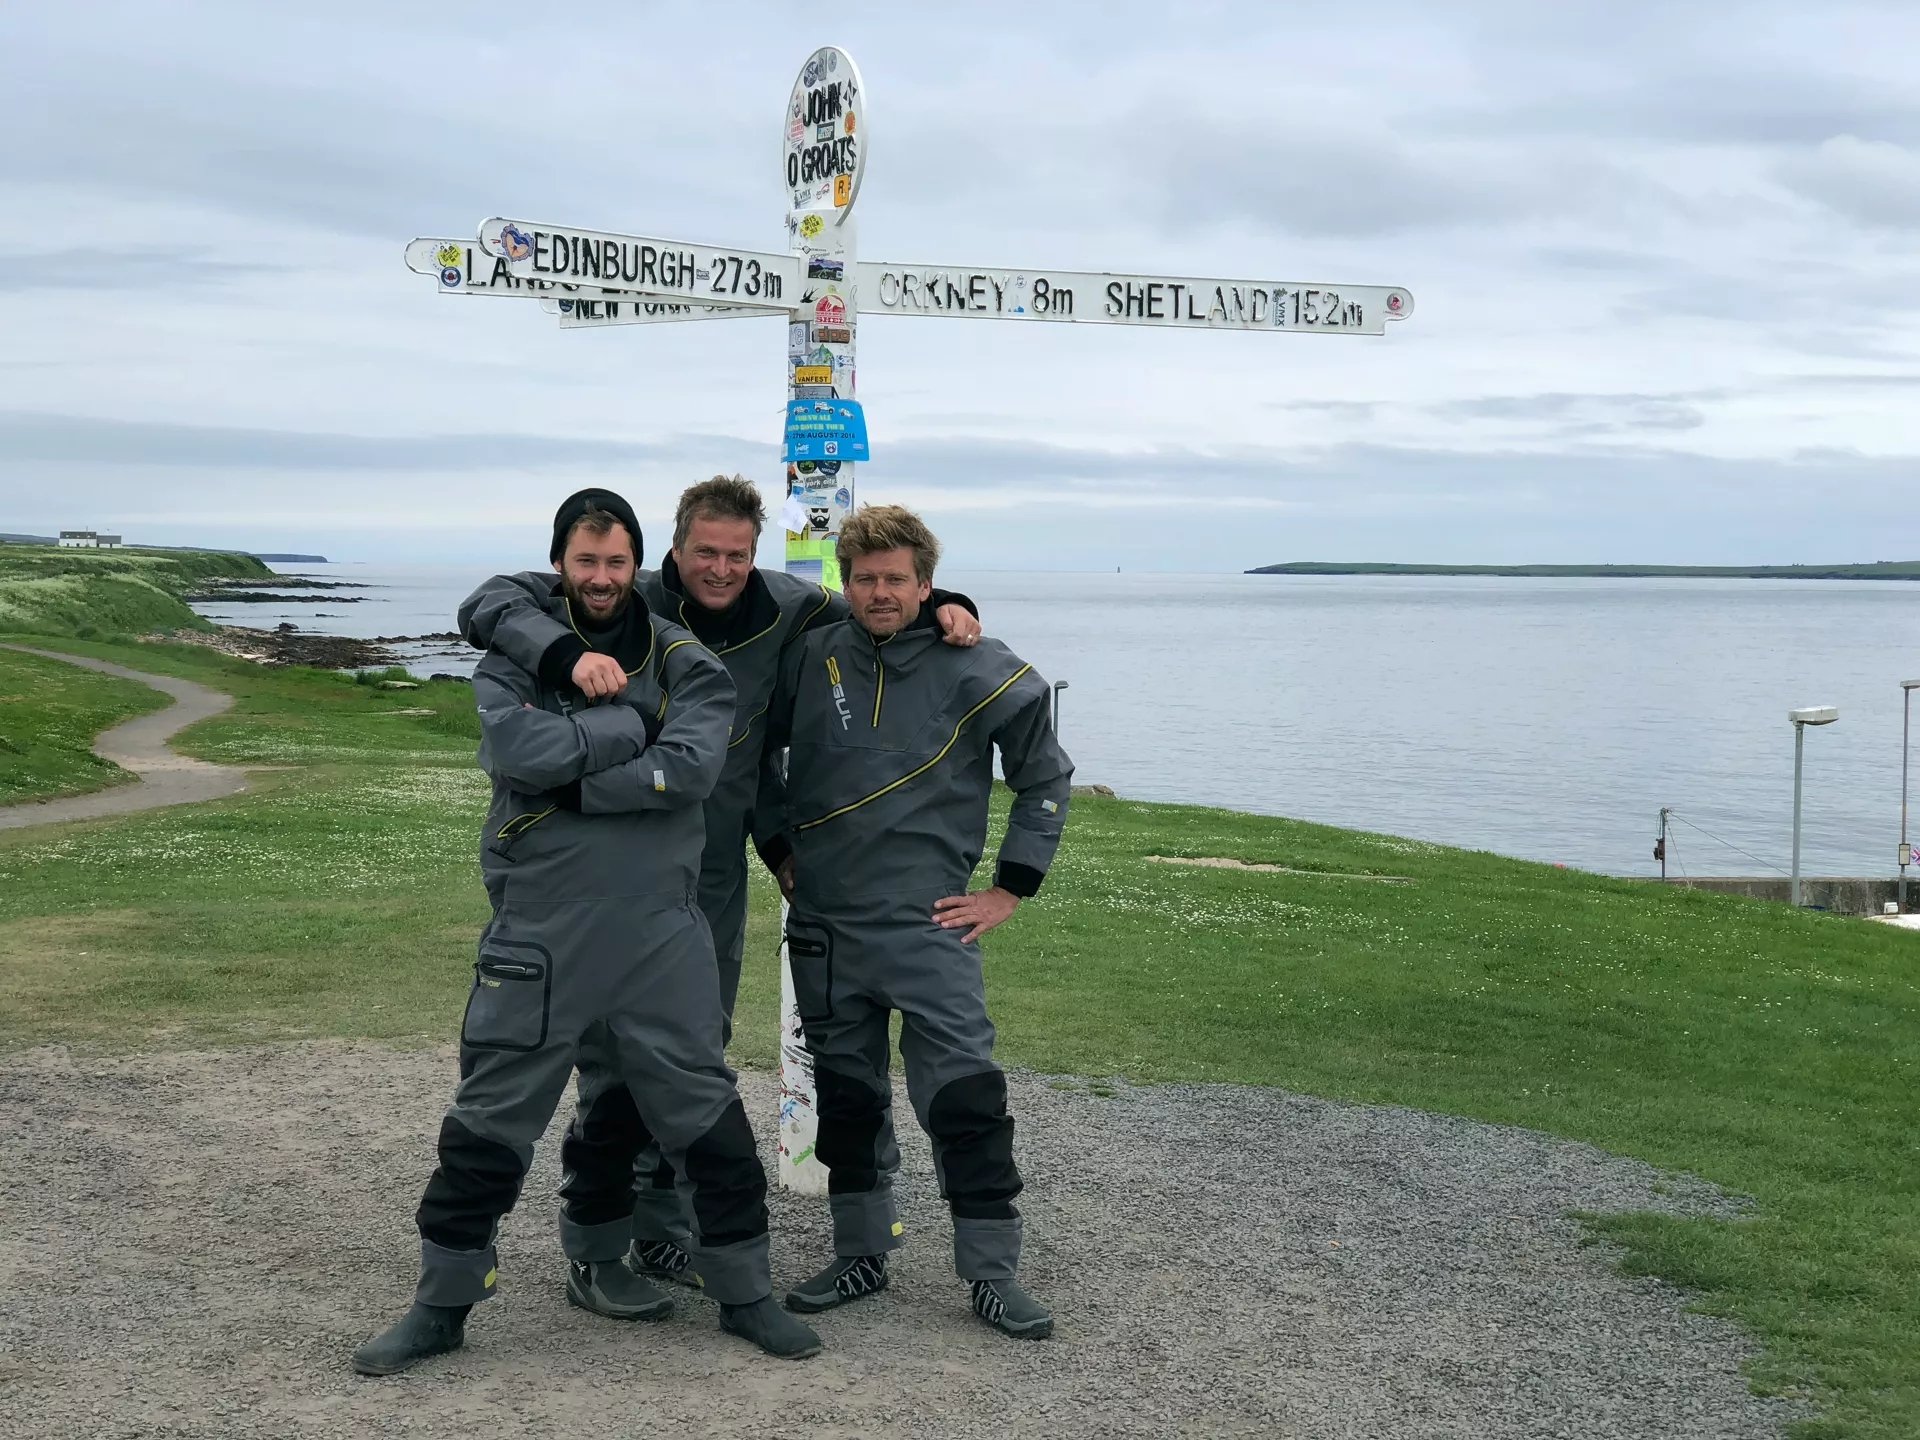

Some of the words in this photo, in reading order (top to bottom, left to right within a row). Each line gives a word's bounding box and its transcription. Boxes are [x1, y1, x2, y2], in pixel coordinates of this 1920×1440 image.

[802, 82, 842, 127] JOHN
[532, 231, 695, 290] EDINBURGH
[710, 256, 782, 299] 273m
[879, 271, 1010, 312] ORKNEY
[1032, 278, 1073, 314] 8m
[1105, 281, 1268, 322] SHETLAND
[1290, 288, 1363, 326] 152m
[1278, 302, 1286, 327] VMX
[832, 683, 852, 731] GUL
